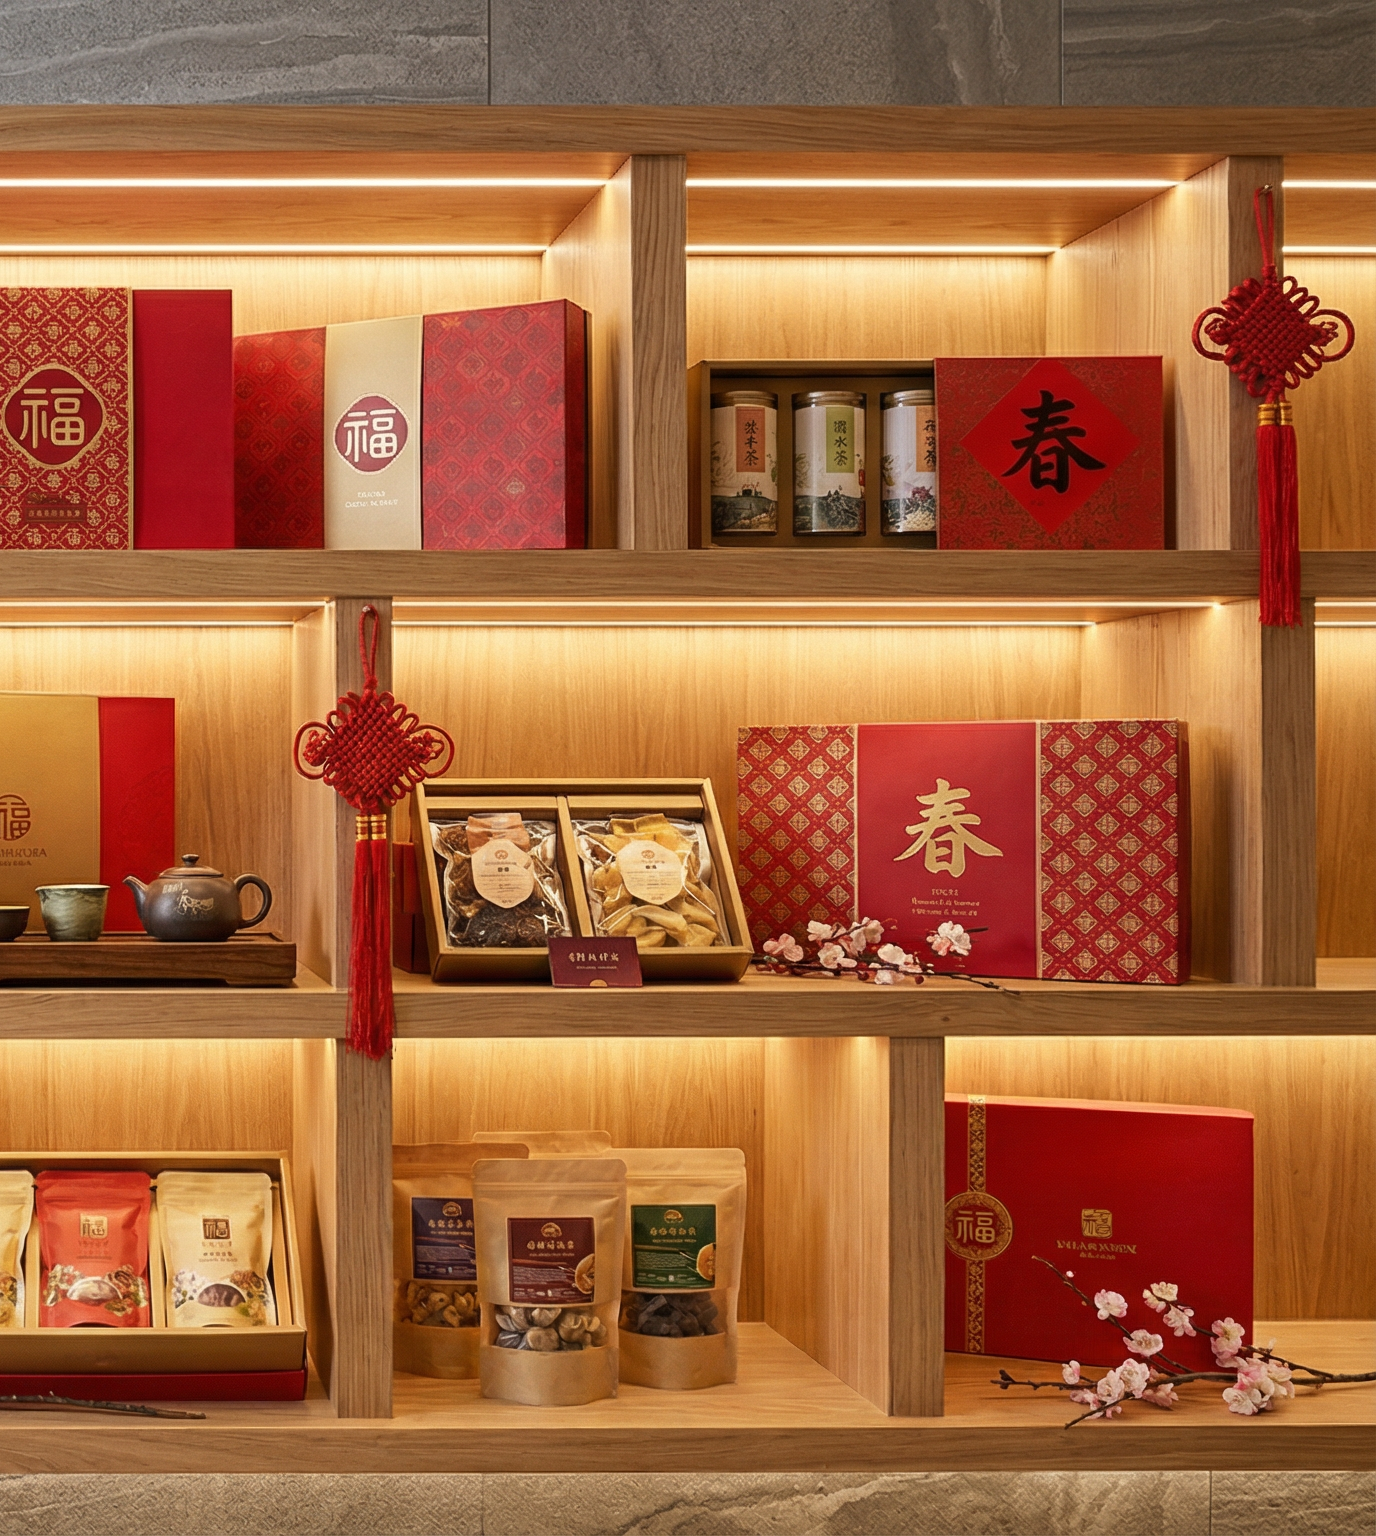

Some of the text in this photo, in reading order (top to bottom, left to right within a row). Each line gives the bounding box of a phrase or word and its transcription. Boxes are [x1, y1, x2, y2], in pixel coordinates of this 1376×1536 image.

[19, 388, 85, 449] 福
[343, 408, 397, 463] 福
[1000, 389, 1107, 494] 春
[892, 777, 1004, 878] 春
[955, 1210, 996, 1244] 福
